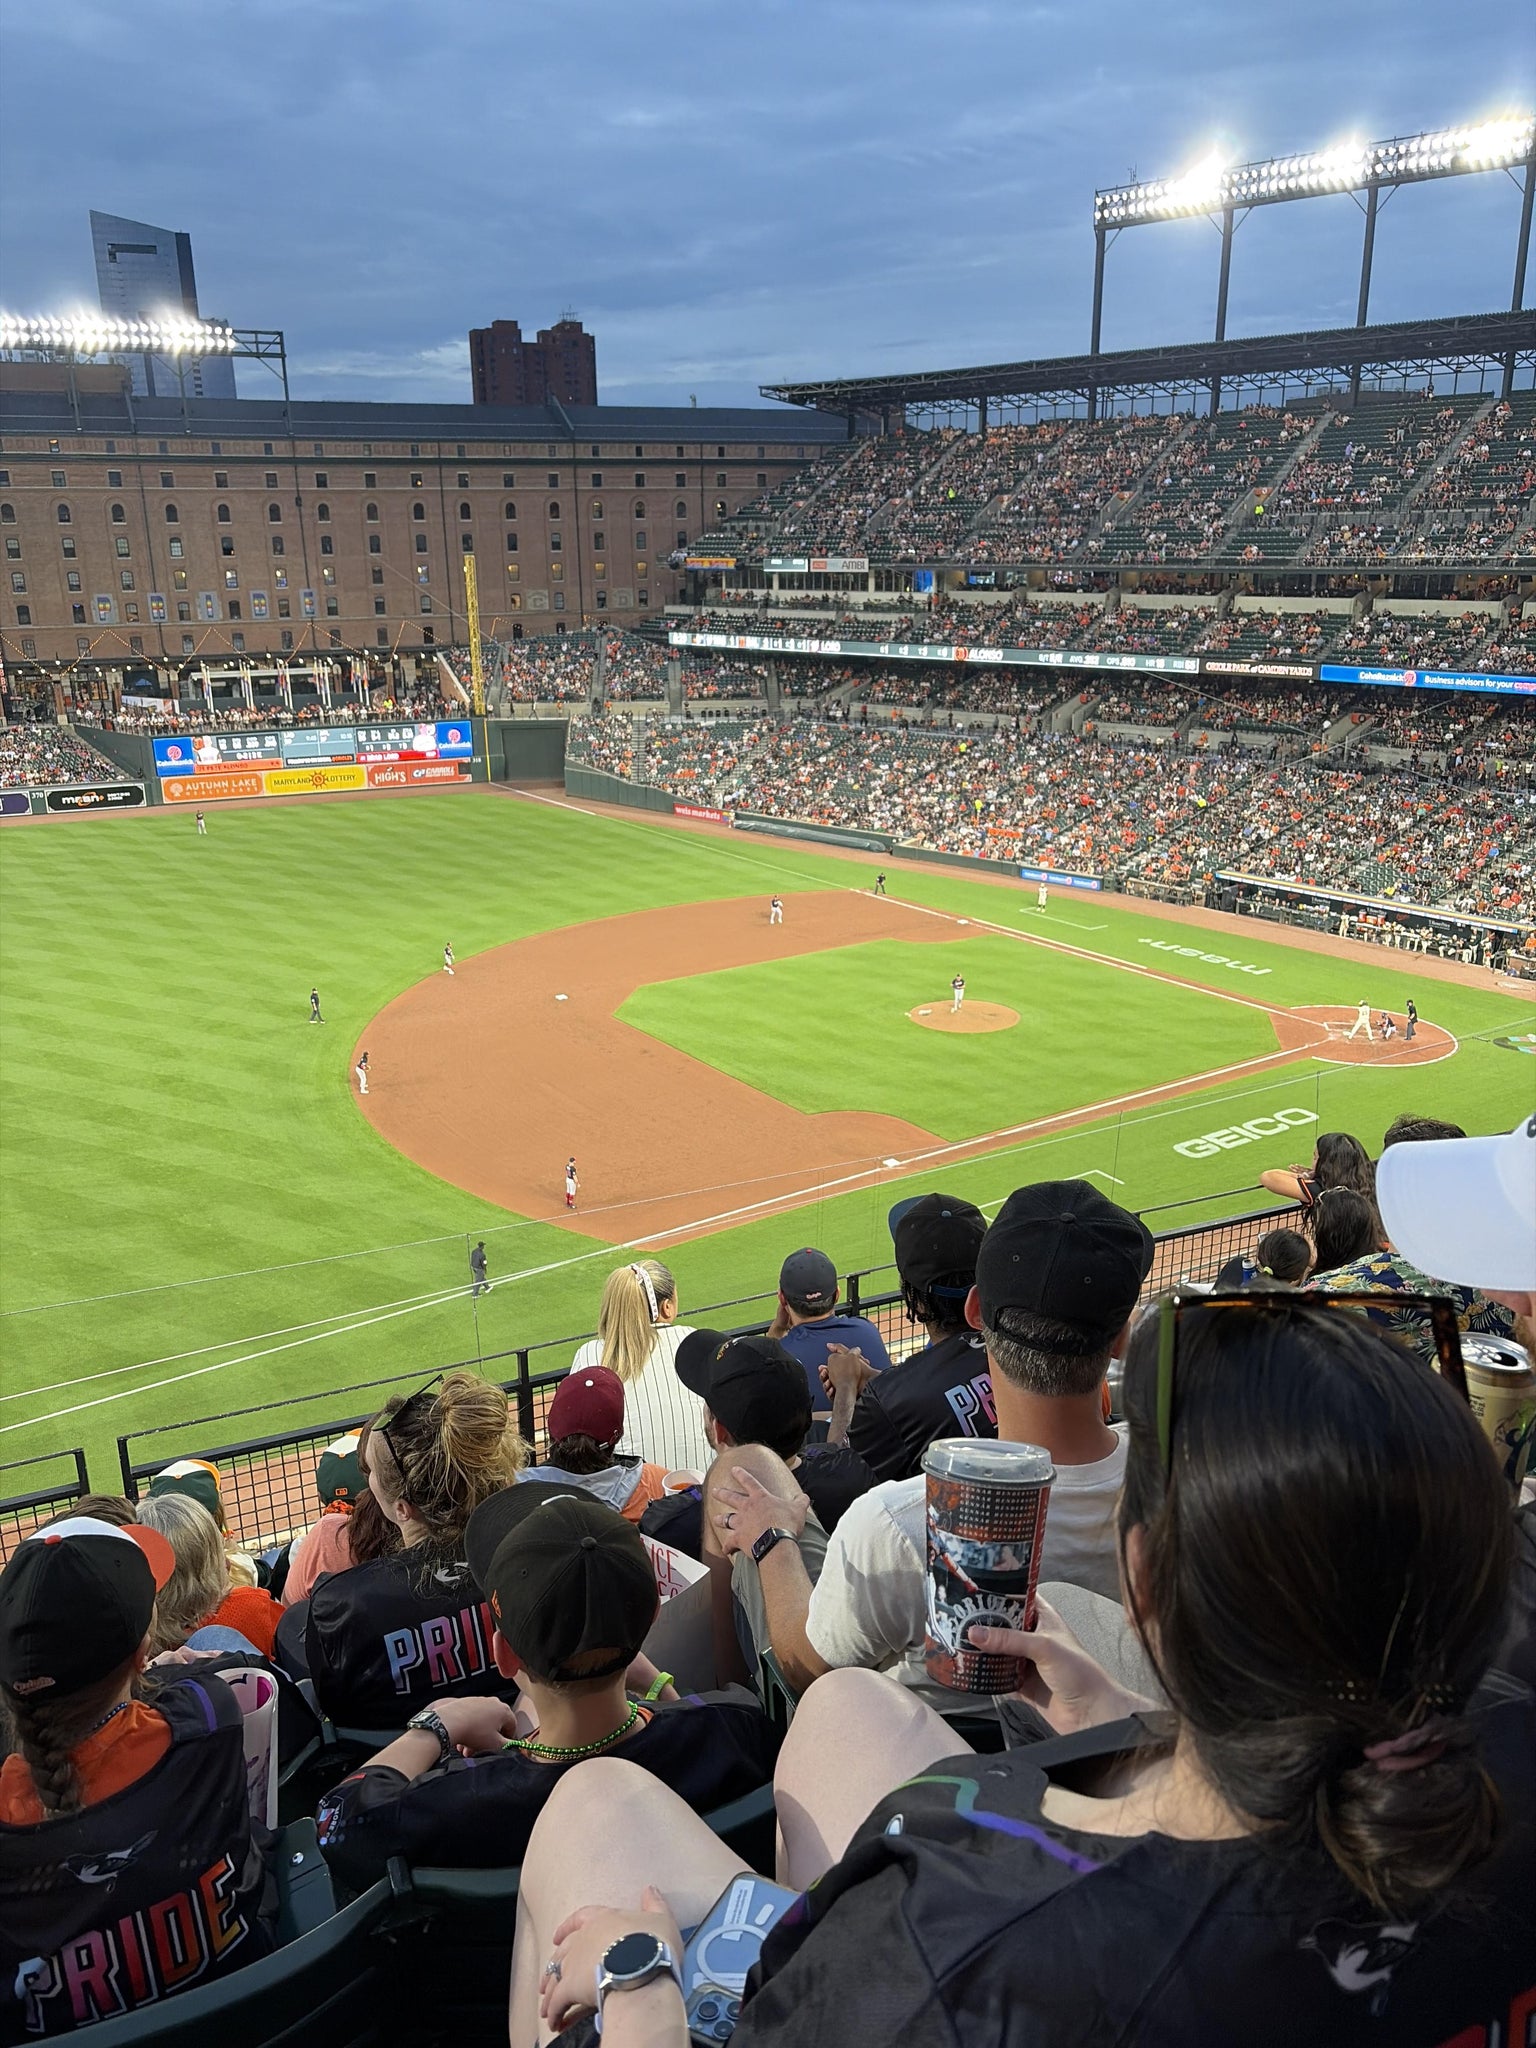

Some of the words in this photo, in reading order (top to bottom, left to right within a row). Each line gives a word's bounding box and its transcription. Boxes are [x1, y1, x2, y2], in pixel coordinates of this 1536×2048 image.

[968, 648, 1004, 661] ALONSO
[1257, 664, 1288, 675] CAMDEN
[1424, 675, 1454, 685] Business
[1455, 677, 1485, 687] advisors
[1485, 678, 1496, 688] for
[1496, 681, 1514, 690] your
[186, 780, 229, 791] AUTUMN
[232, 778, 257, 788] LAKE
[273, 777, 311, 786] MARYLAND
[326, 774, 356, 783] LOTTERY
[375, 771, 406, 785] HIGH'S
[691, 809, 721, 821] markets
[1173, 1107, 1320, 1159] GEICO
[14, 1851, 250, 2033] PRIDE
